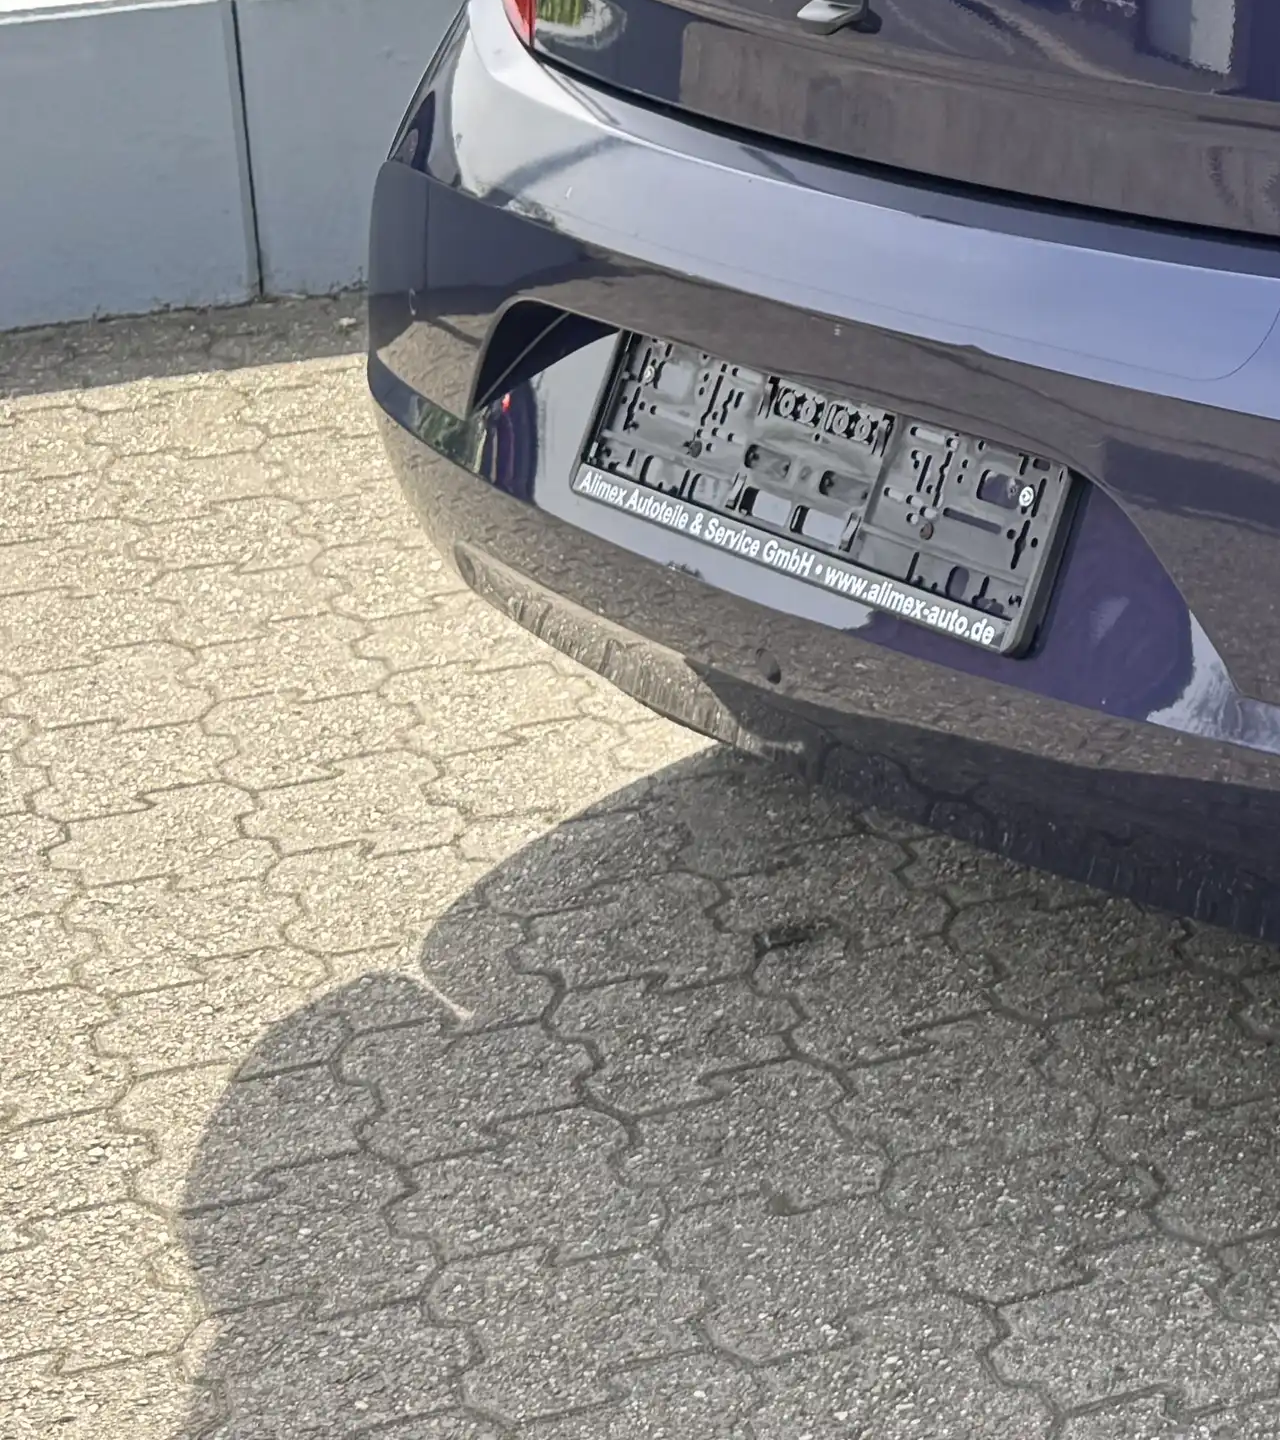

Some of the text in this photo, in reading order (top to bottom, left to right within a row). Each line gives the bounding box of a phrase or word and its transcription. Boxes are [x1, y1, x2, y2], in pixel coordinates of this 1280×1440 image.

[578, 471, 995, 645] Alimex Autoteile & Service GmbH www.alimex-auto.de
